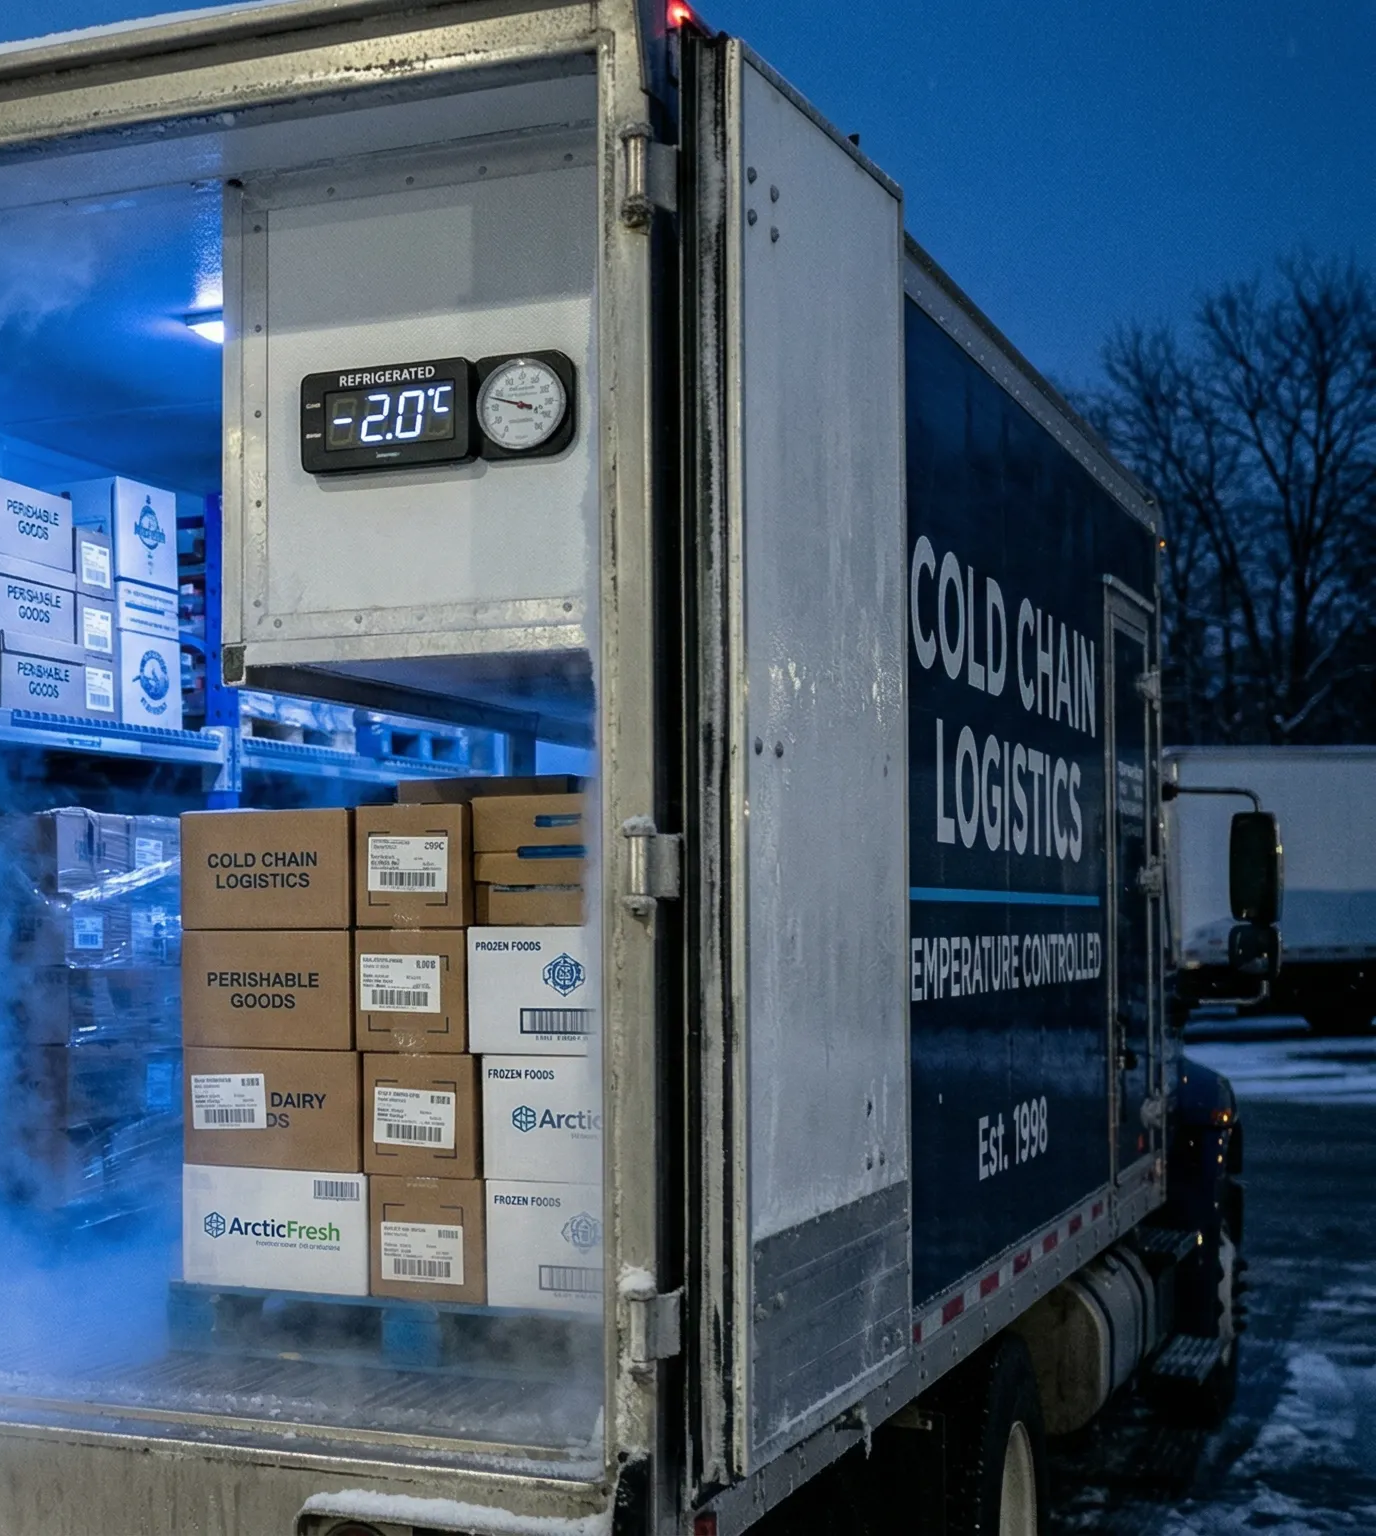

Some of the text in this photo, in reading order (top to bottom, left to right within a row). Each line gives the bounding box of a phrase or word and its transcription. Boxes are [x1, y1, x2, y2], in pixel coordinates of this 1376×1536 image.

[339, 366, 435, 387] REFRIGERATED
[911, 536, 1096, 738] COLD CHAIN
[936, 718, 1082, 863] LOGISTICS
[207, 852, 318, 868] COLD CHAIN
[216, 872, 310, 889] LOGISTICS
[511, 941, 541, 951] FOODS
[911, 932, 1101, 1001] EMPERATURE CONTROLLED
[207, 972, 319, 988] PERISHABLE
[230, 993, 295, 1009] GOODS
[488, 1069, 554, 1080] FROZEN FOODS
[271, 1092, 326, 1109] DAIRY
[978, 1095, 1048, 1181] Est. 1998
[494, 1195, 561, 1207] FROZEN FOODS
[228, 1217, 340, 1241] ArcticFresh
